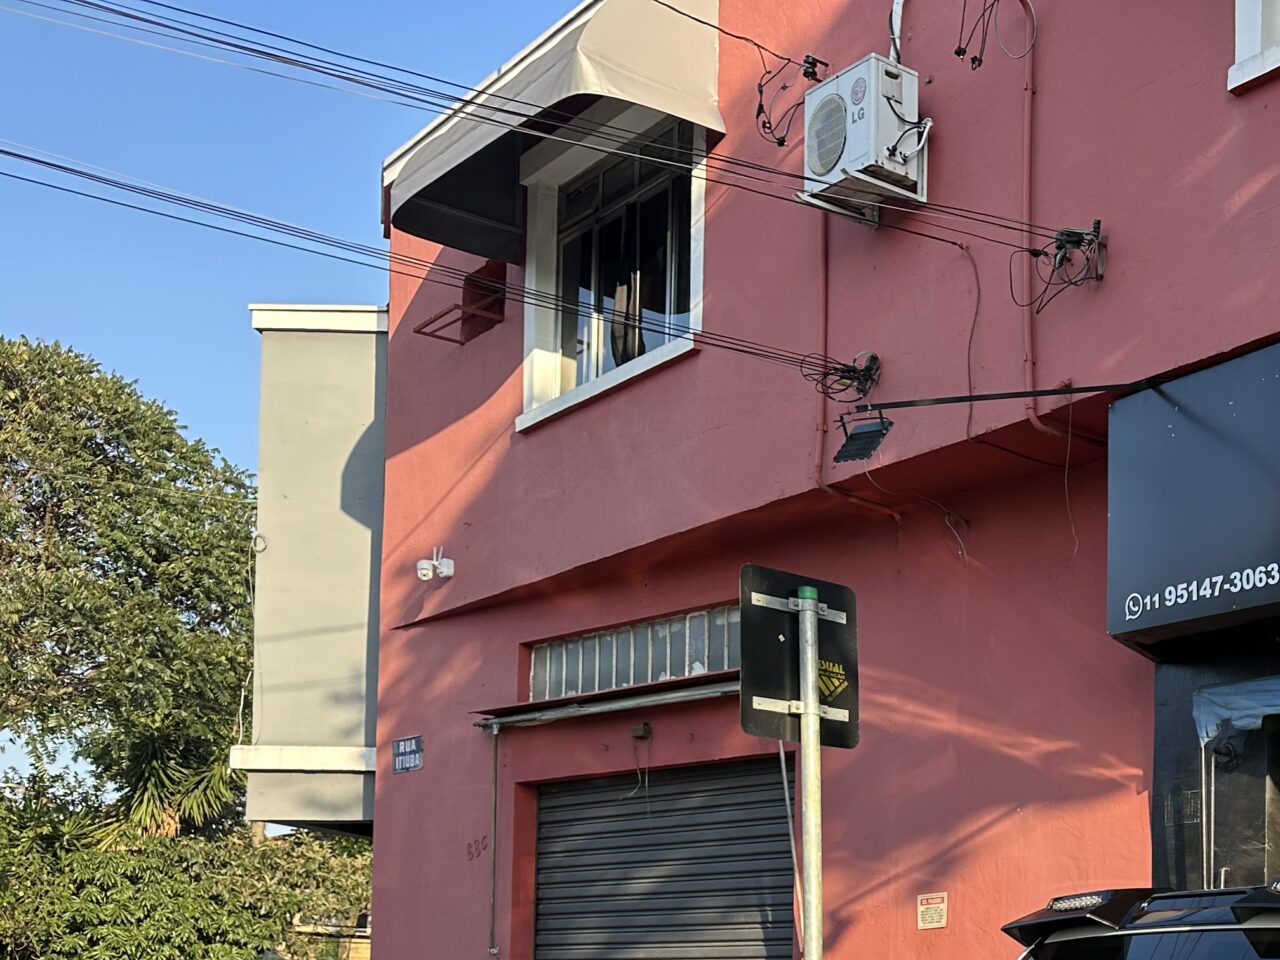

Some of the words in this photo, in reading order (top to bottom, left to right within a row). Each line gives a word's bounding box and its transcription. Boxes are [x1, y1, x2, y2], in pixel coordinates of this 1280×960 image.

[851, 107, 865, 124] LG
[1143, 593, 1160, 610] 11
[1164, 562, 1280, 607] 95147-3063
[399, 739, 417, 753] RUA
